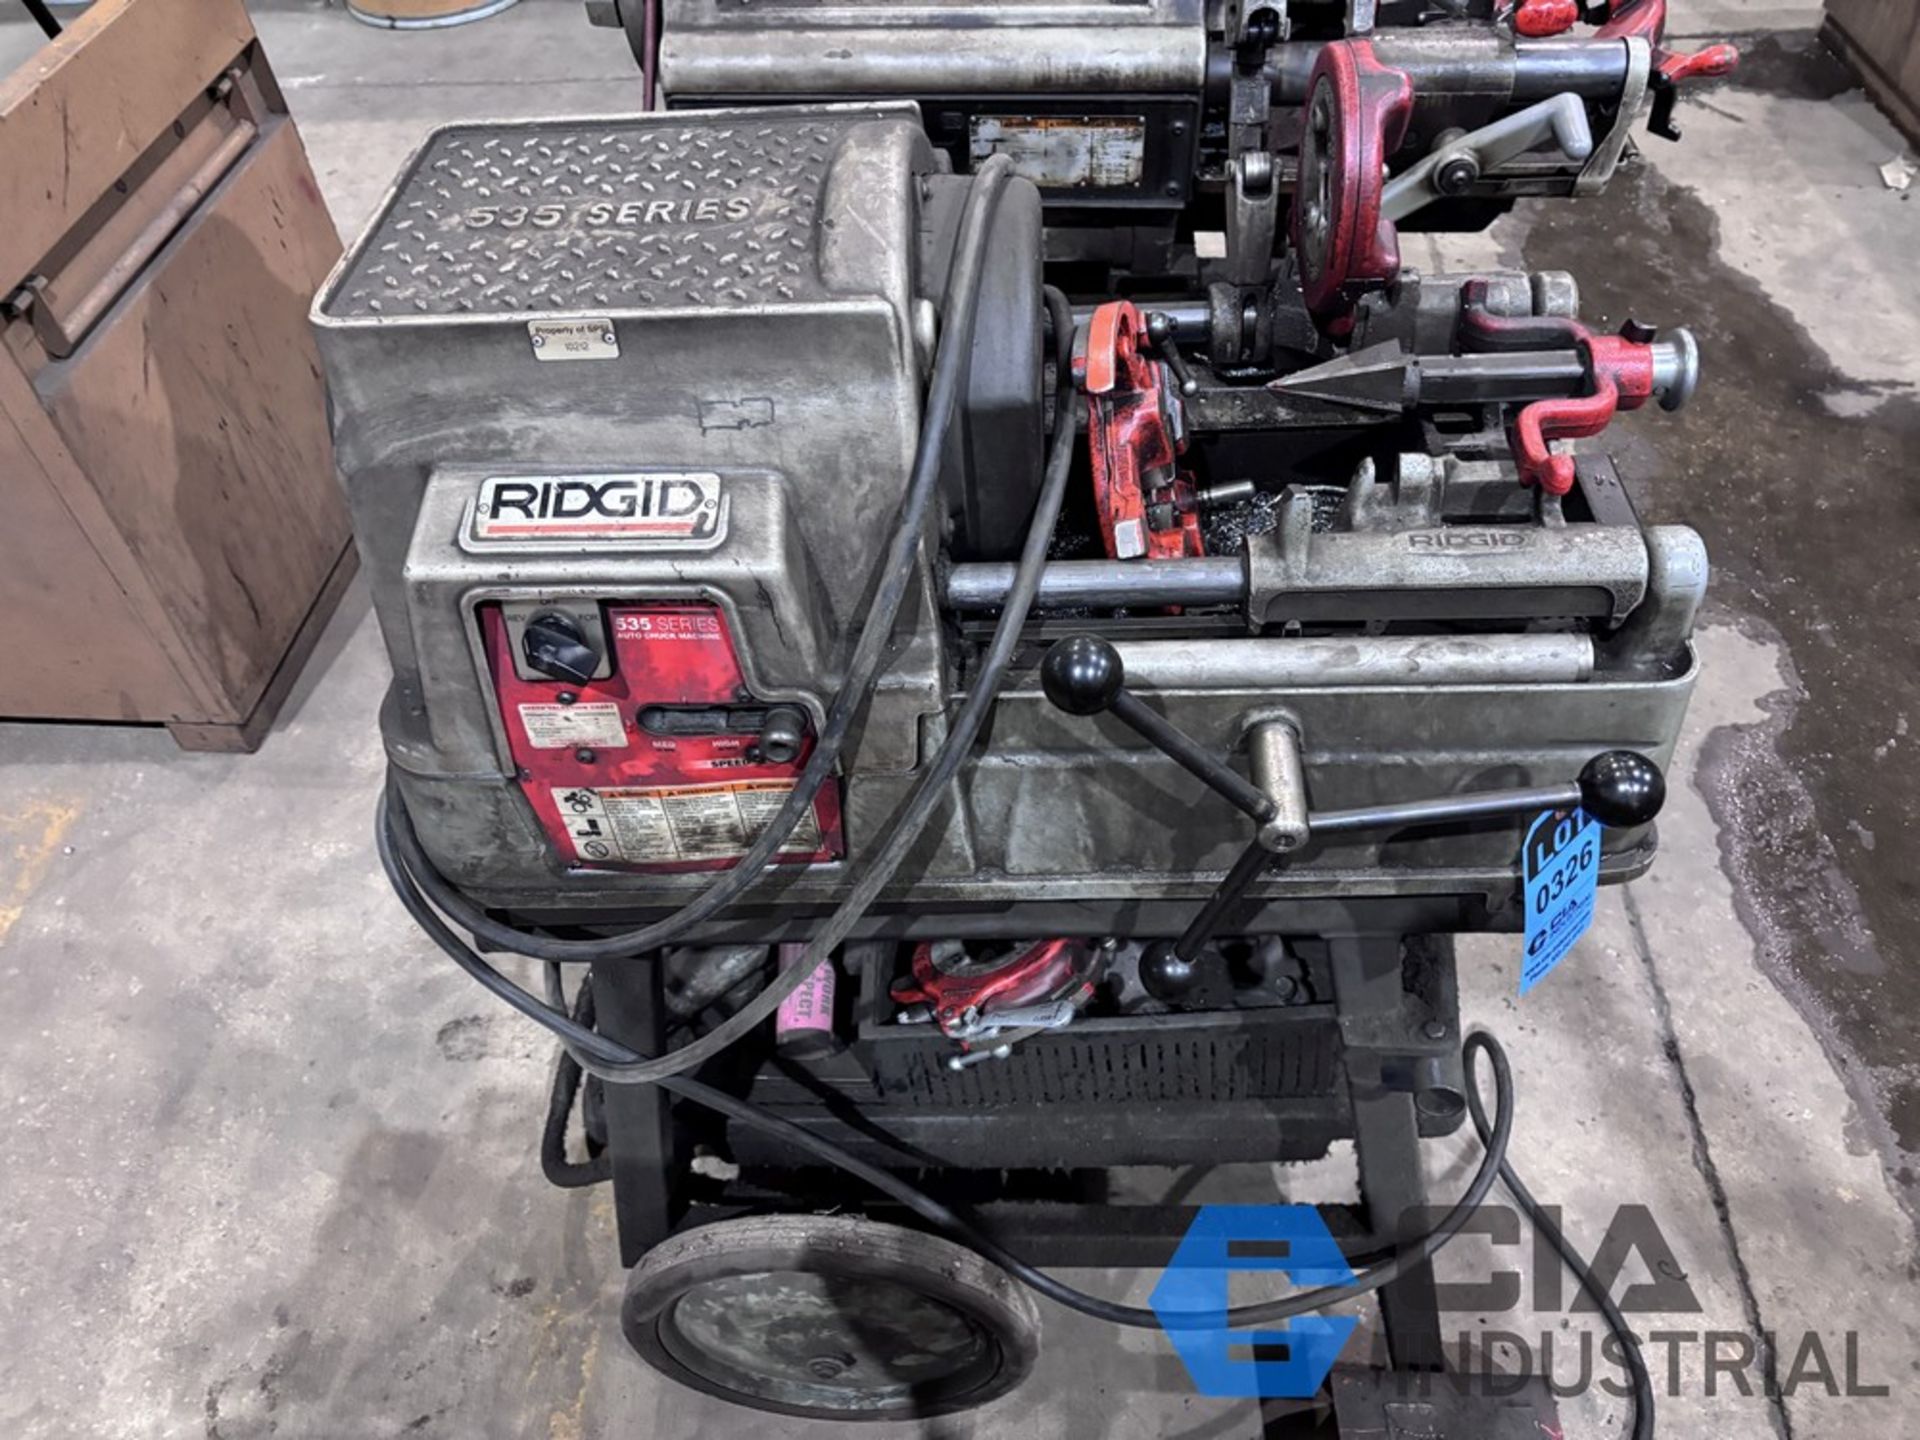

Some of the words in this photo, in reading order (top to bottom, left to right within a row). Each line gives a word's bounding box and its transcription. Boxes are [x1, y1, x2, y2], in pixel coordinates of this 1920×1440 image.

[465, 204, 565, 228] 535
[585, 197, 753, 227] SERIES
[576, 325, 585, 333] of
[489, 479, 706, 520] RIDGID
[1408, 532, 1526, 548] RIDGID
[578, 613, 599, 622] FOR
[615, 617, 652, 631] 535
[656, 616, 721, 632] SERIES
[616, 632, 642, 640] AUTO
[644, 632, 677, 640] CHUCK
[678, 632, 721, 641] MACHINE
[712, 739, 740, 748] HIGH
[1536, 807, 1585, 869] LOT
[1536, 840, 1593, 914] 0326
